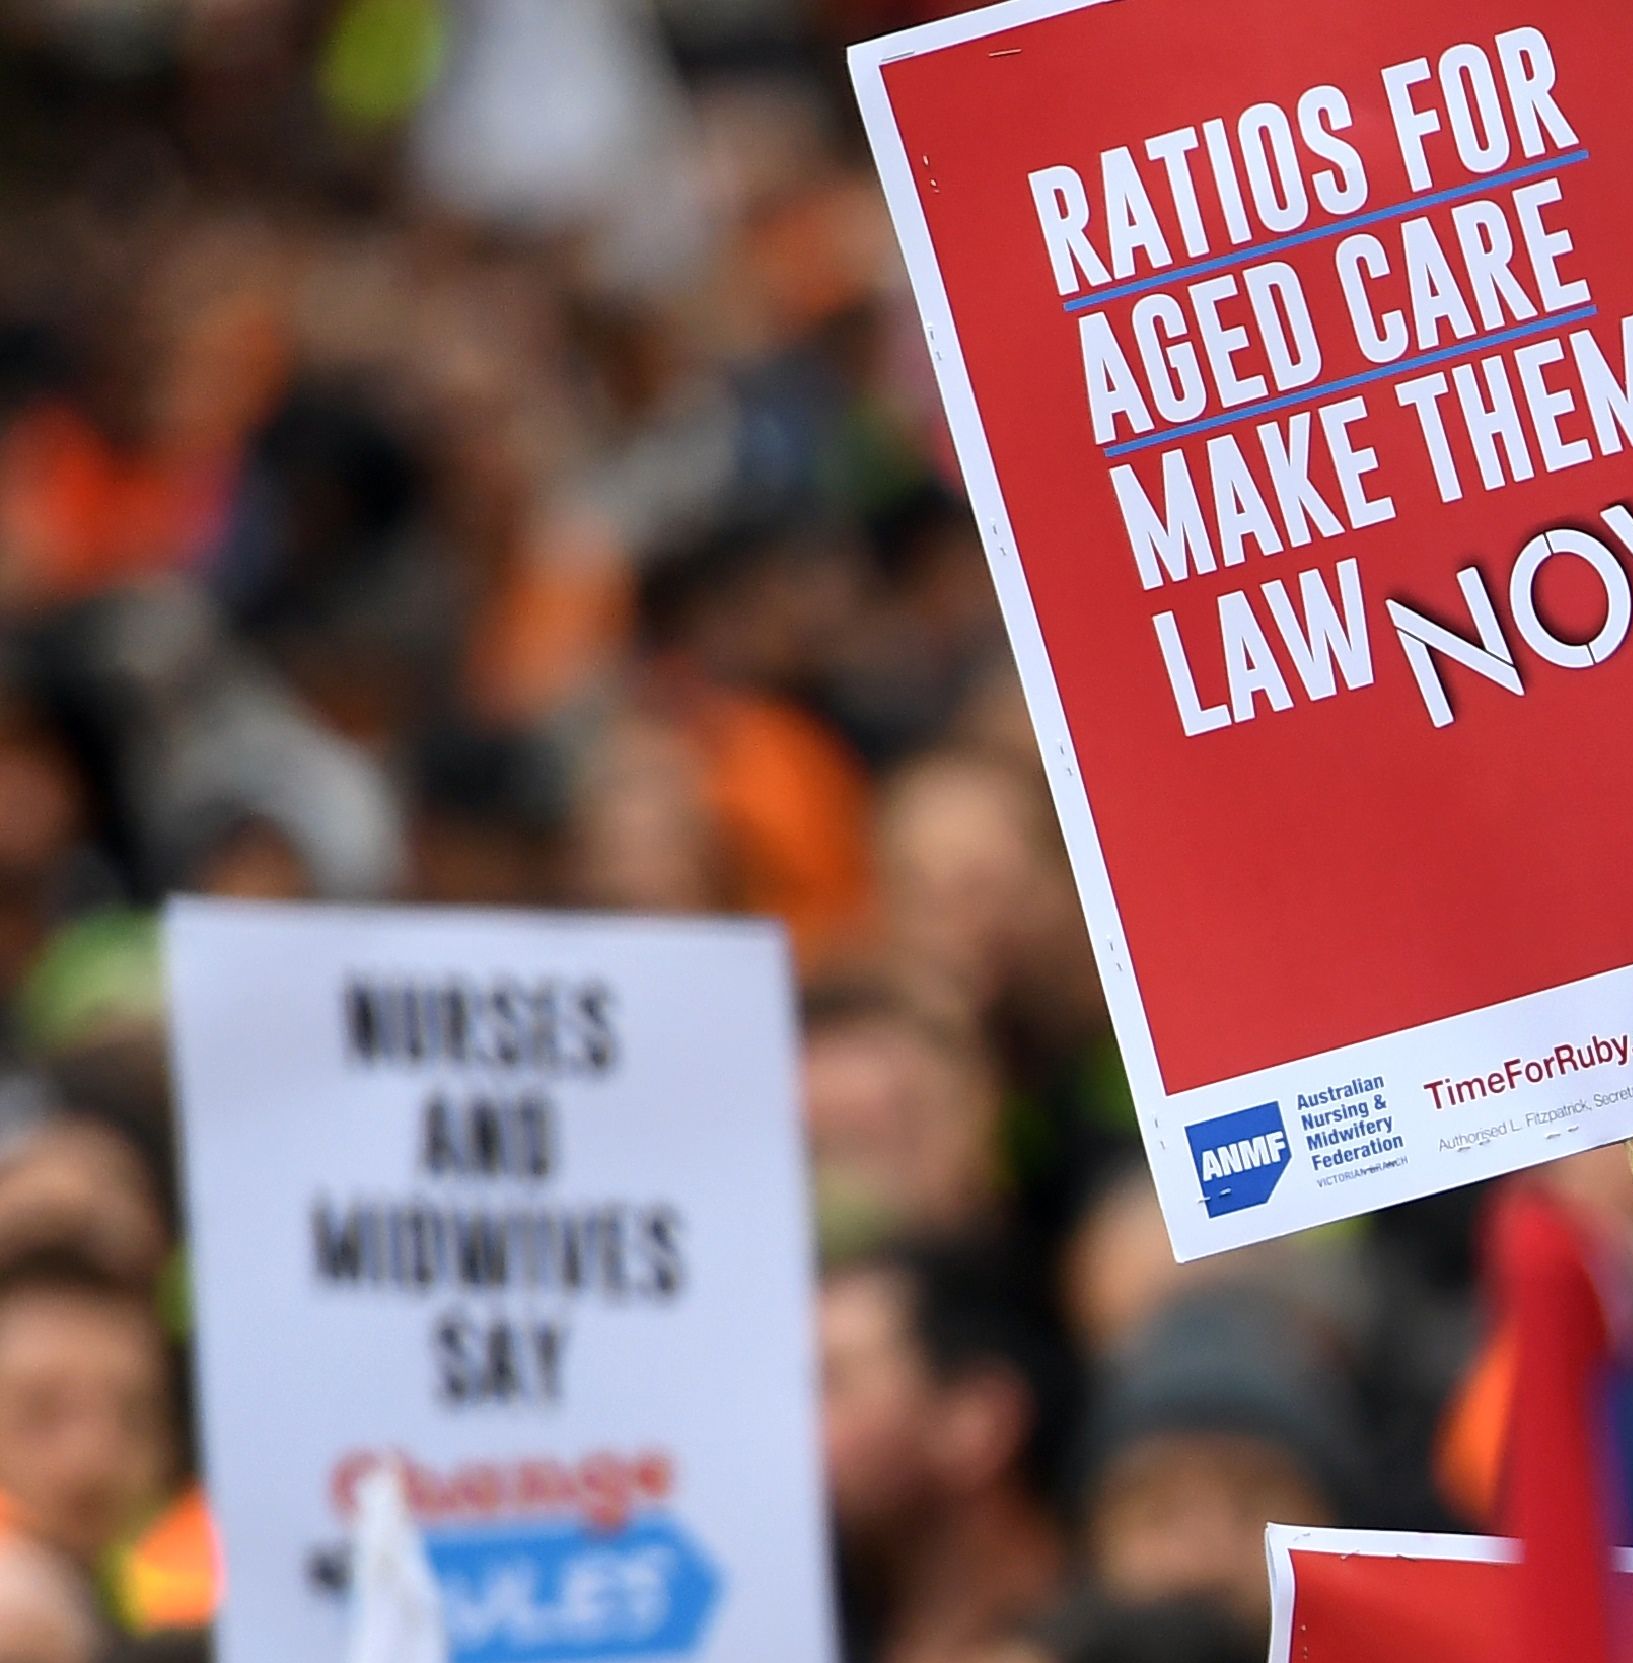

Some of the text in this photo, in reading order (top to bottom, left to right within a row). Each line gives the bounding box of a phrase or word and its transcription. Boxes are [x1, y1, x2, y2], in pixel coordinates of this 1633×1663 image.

[1028, 25, 1579, 296] RATIOS FOR
[1078, 178, 1592, 445] AGED CARE
[1109, 394, 1396, 591] MAKE
[1152, 557, 1374, 737] LAW
[342, 971, 618, 1073] NURSES
[418, 1092, 560, 1178] AND
[1297, 1075, 1385, 1111] Australian
[1300, 1093, 1388, 1132] Nursing &
[1306, 1115, 1393, 1151] Midwifery
[1202, 1131, 1287, 1182] ANMF
[1311, 1135, 1404, 1172] Federation
[309, 1190, 689, 1301] MIDWIVES
[432, 1318, 572, 1412] SAY
